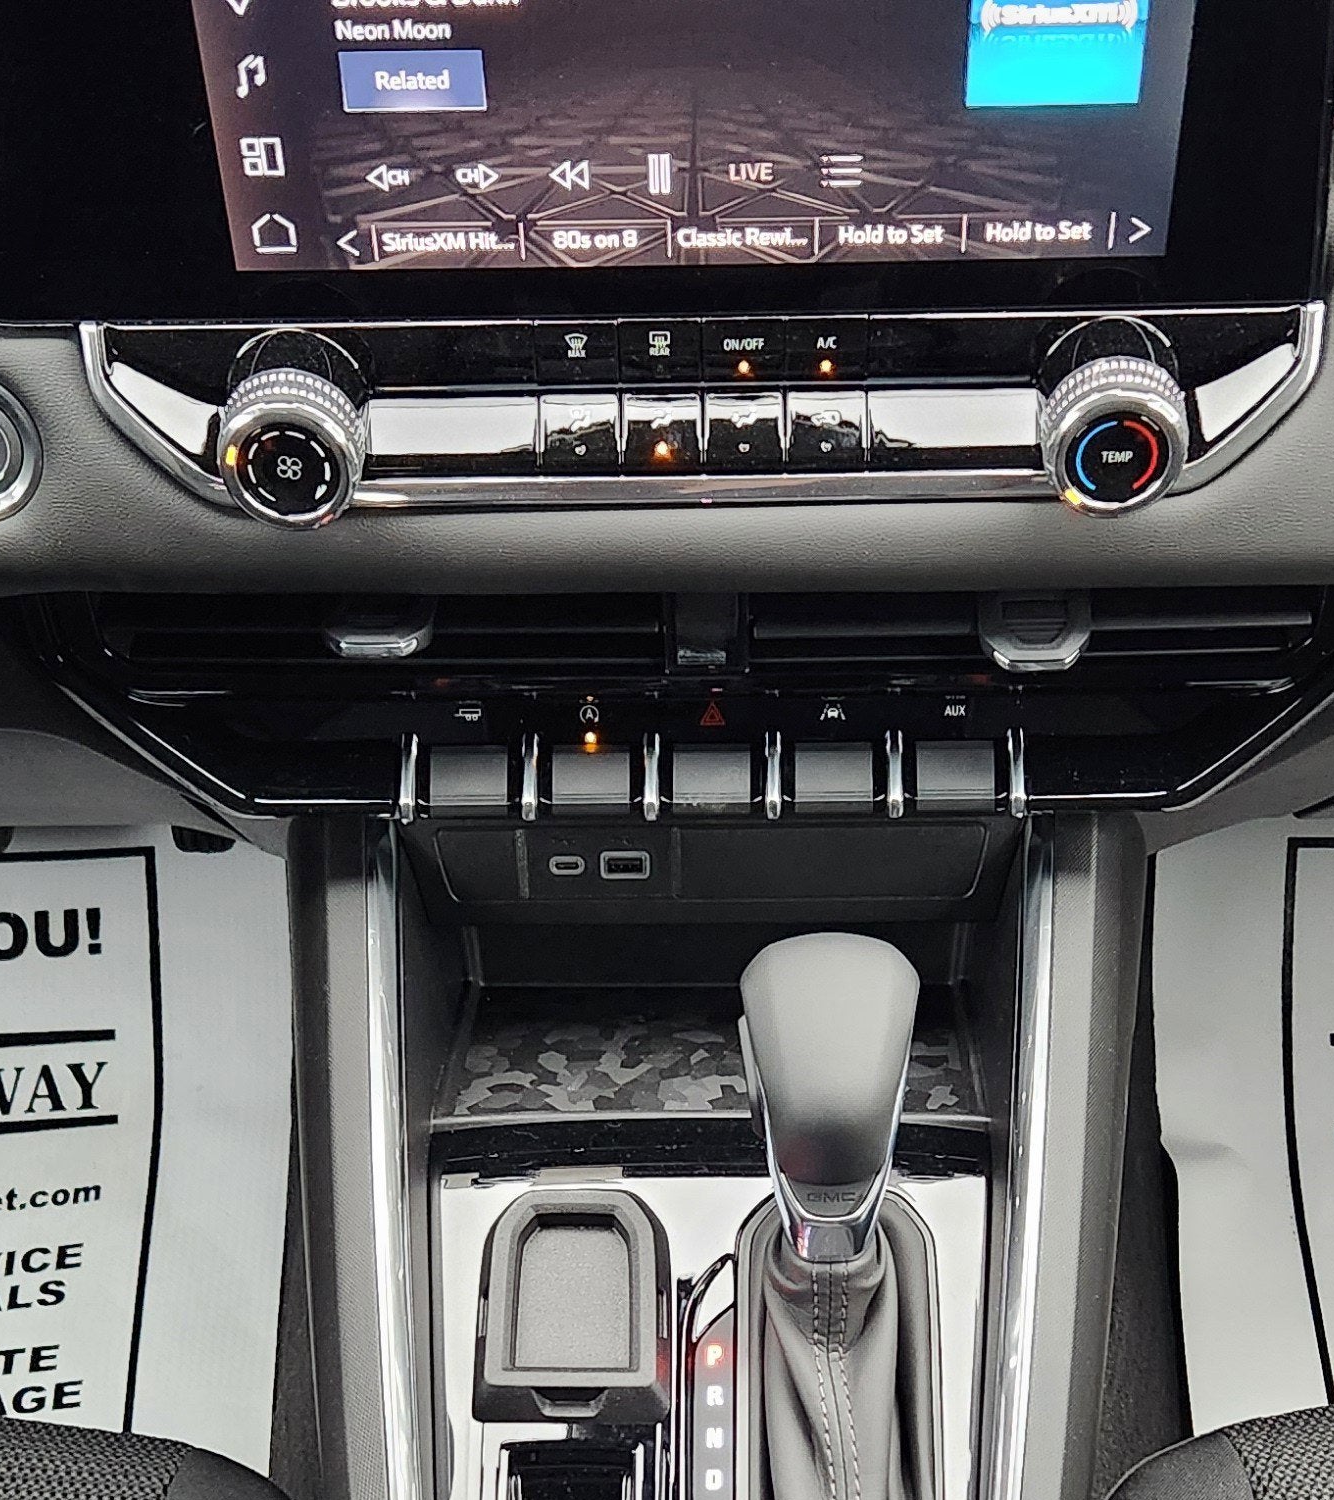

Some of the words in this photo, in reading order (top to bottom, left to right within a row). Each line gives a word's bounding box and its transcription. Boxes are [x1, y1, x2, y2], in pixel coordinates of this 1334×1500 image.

[334, 19, 390, 41] Neon
[392, 18, 452, 40] Moon
[374, 69, 451, 91] Related
[728, 162, 774, 181] LIVE
[381, 232, 466, 251] SiriusXM
[553, 230, 591, 249] 80s
[594, 233, 620, 249] on
[622, 229, 638, 248] 8
[676, 227, 743, 248] Classic
[838, 224, 885, 245] Hold
[887, 226, 908, 244] to
[910, 224, 946, 244] Set
[985, 221, 1032, 243] Hold
[1033, 224, 1055, 242] to
[1057, 219, 1093, 241] Set
[723, 337, 765, 351] ON/OFF
[817, 337, 838, 349] A/C
[1101, 451, 1134, 463] TEMP
[944, 704, 966, 717] AUX
[706, 1344, 722, 1367] P
[706, 1385, 723, 1406] R
[706, 1427, 723, 1449] N
